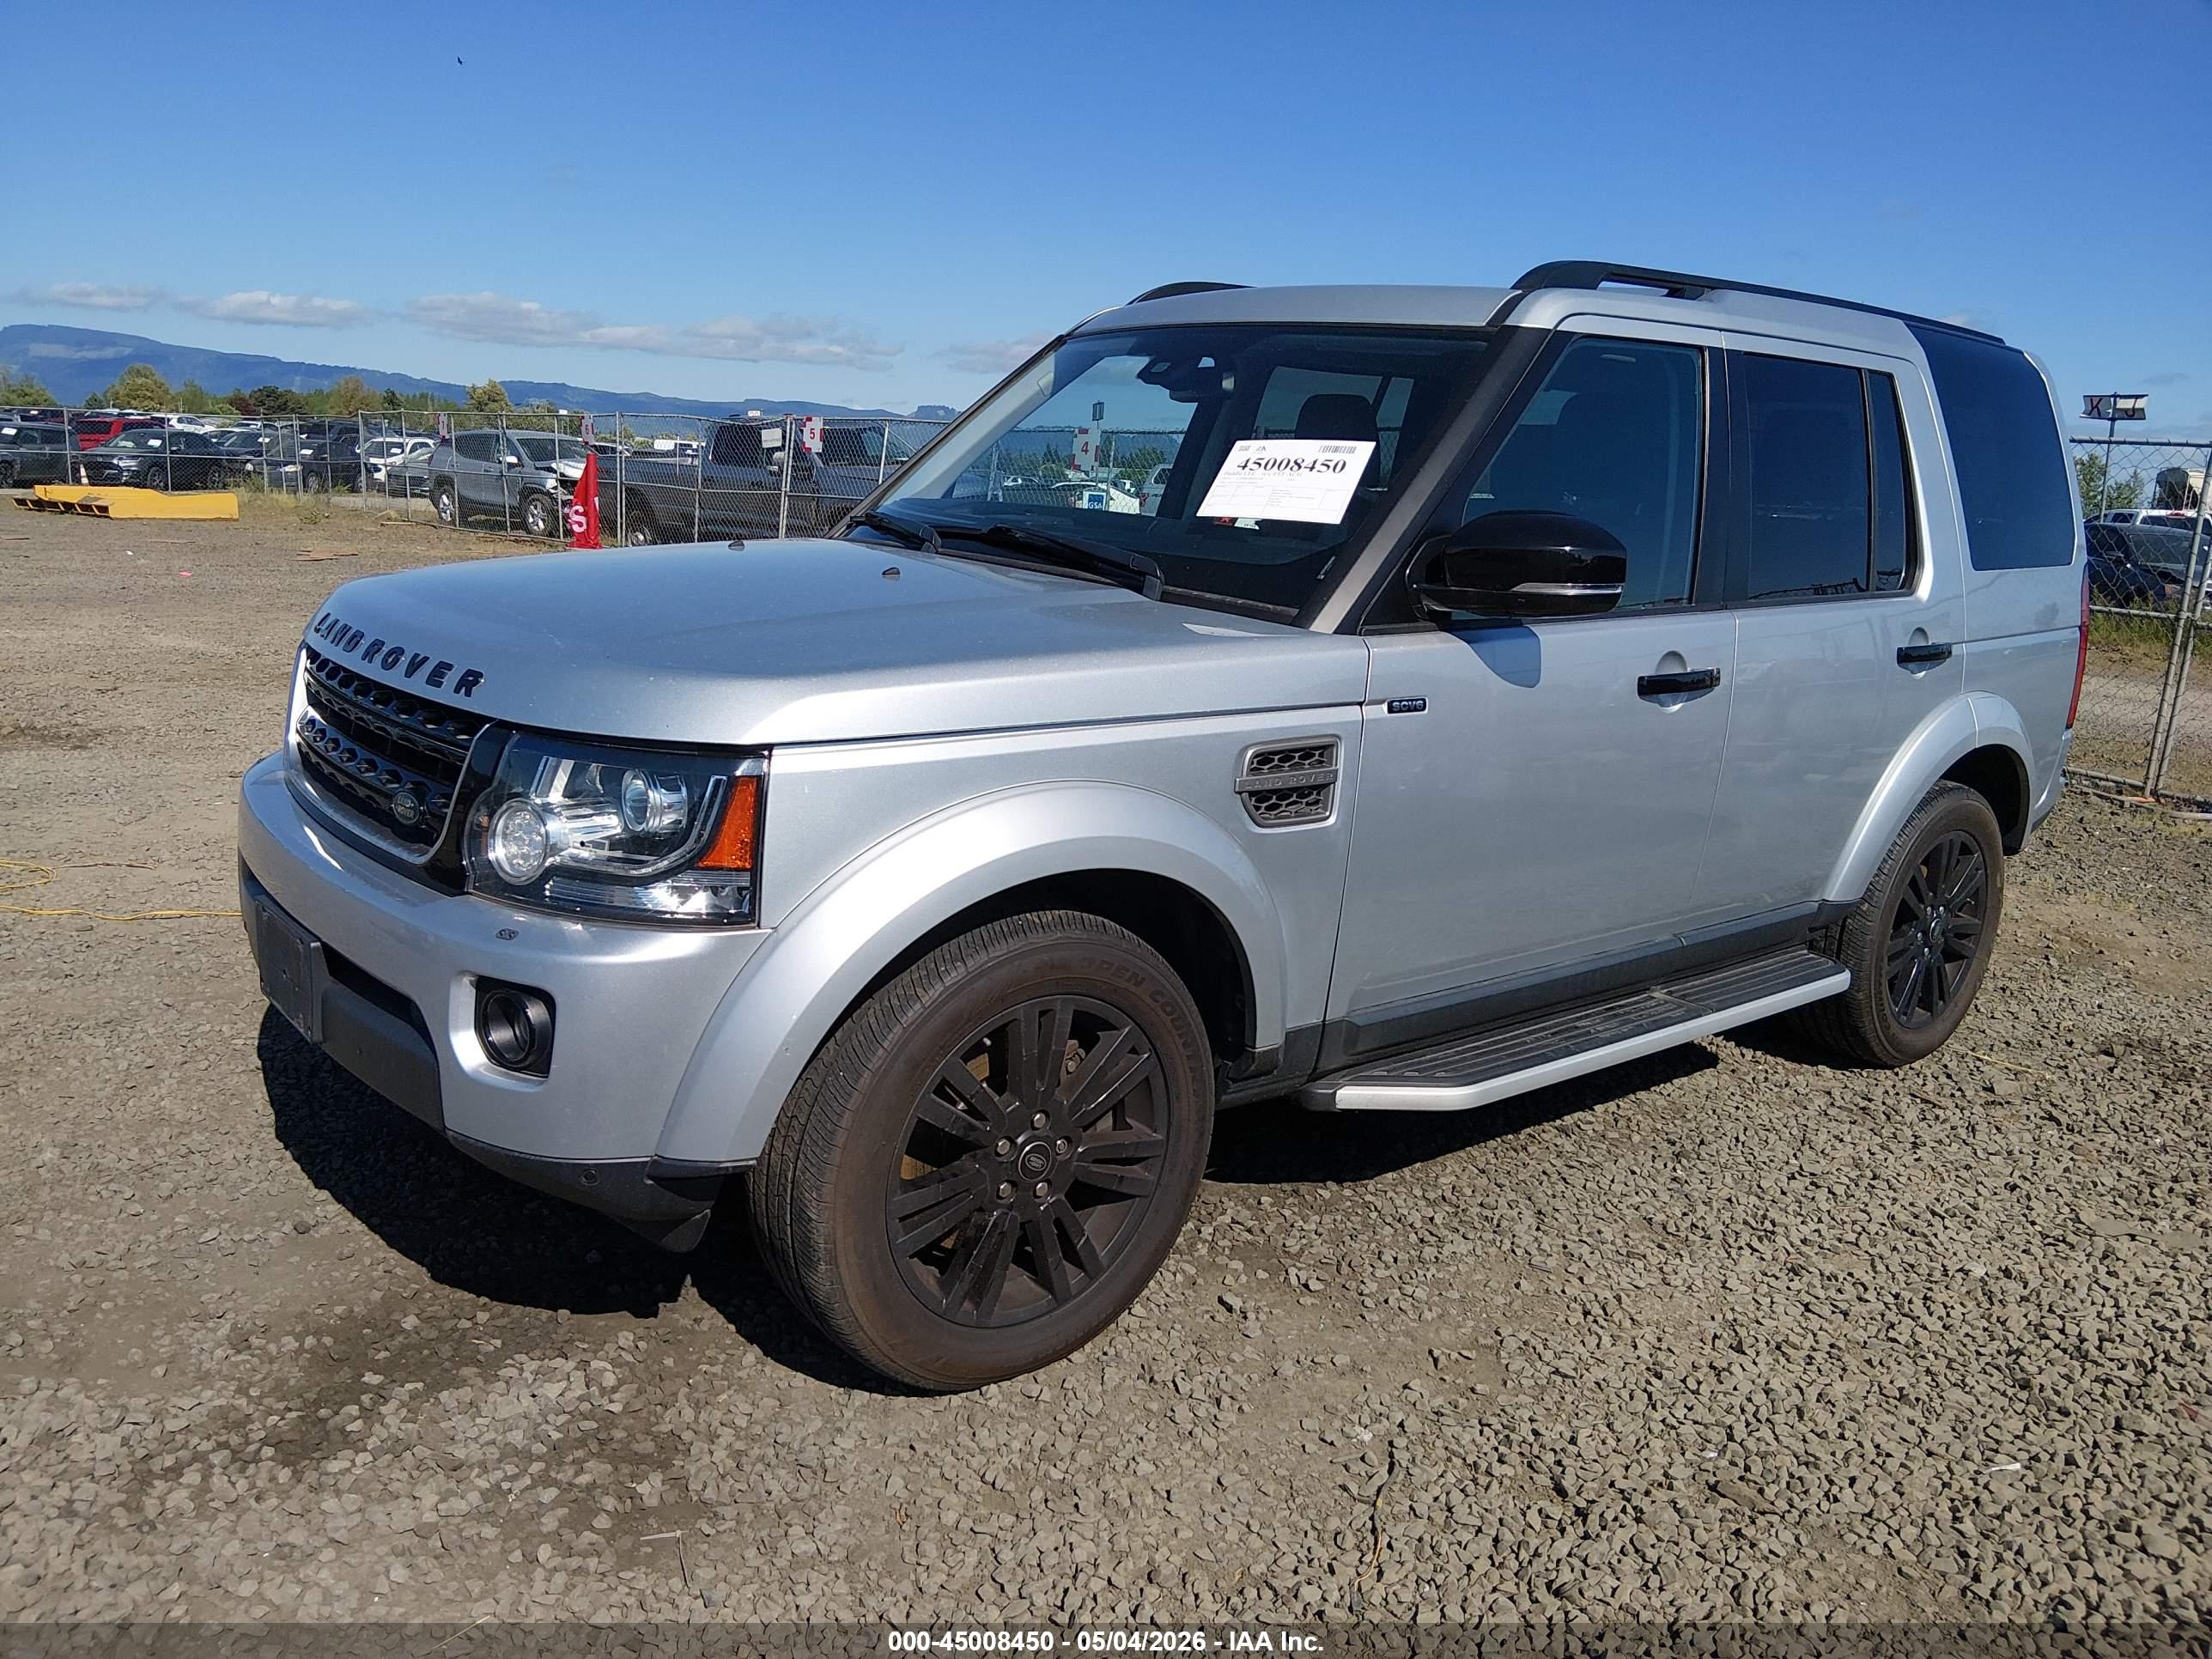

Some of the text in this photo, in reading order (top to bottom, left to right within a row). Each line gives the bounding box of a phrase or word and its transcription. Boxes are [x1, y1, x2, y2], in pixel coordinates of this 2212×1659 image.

[2087, 398, 2102, 417] K
[2125, 398, 2137, 417] J
[585, 424, 590, 434] 6
[810, 428, 816, 440] 5
[1081, 441, 1090, 455] 4
[1237, 457, 1347, 474] 45008450
[569, 505, 587, 533] S
[313, 612, 484, 698] LAND ROVER
[1392, 700, 1425, 712] SCV6
[1245, 773, 1334, 790] LAND ROVER
